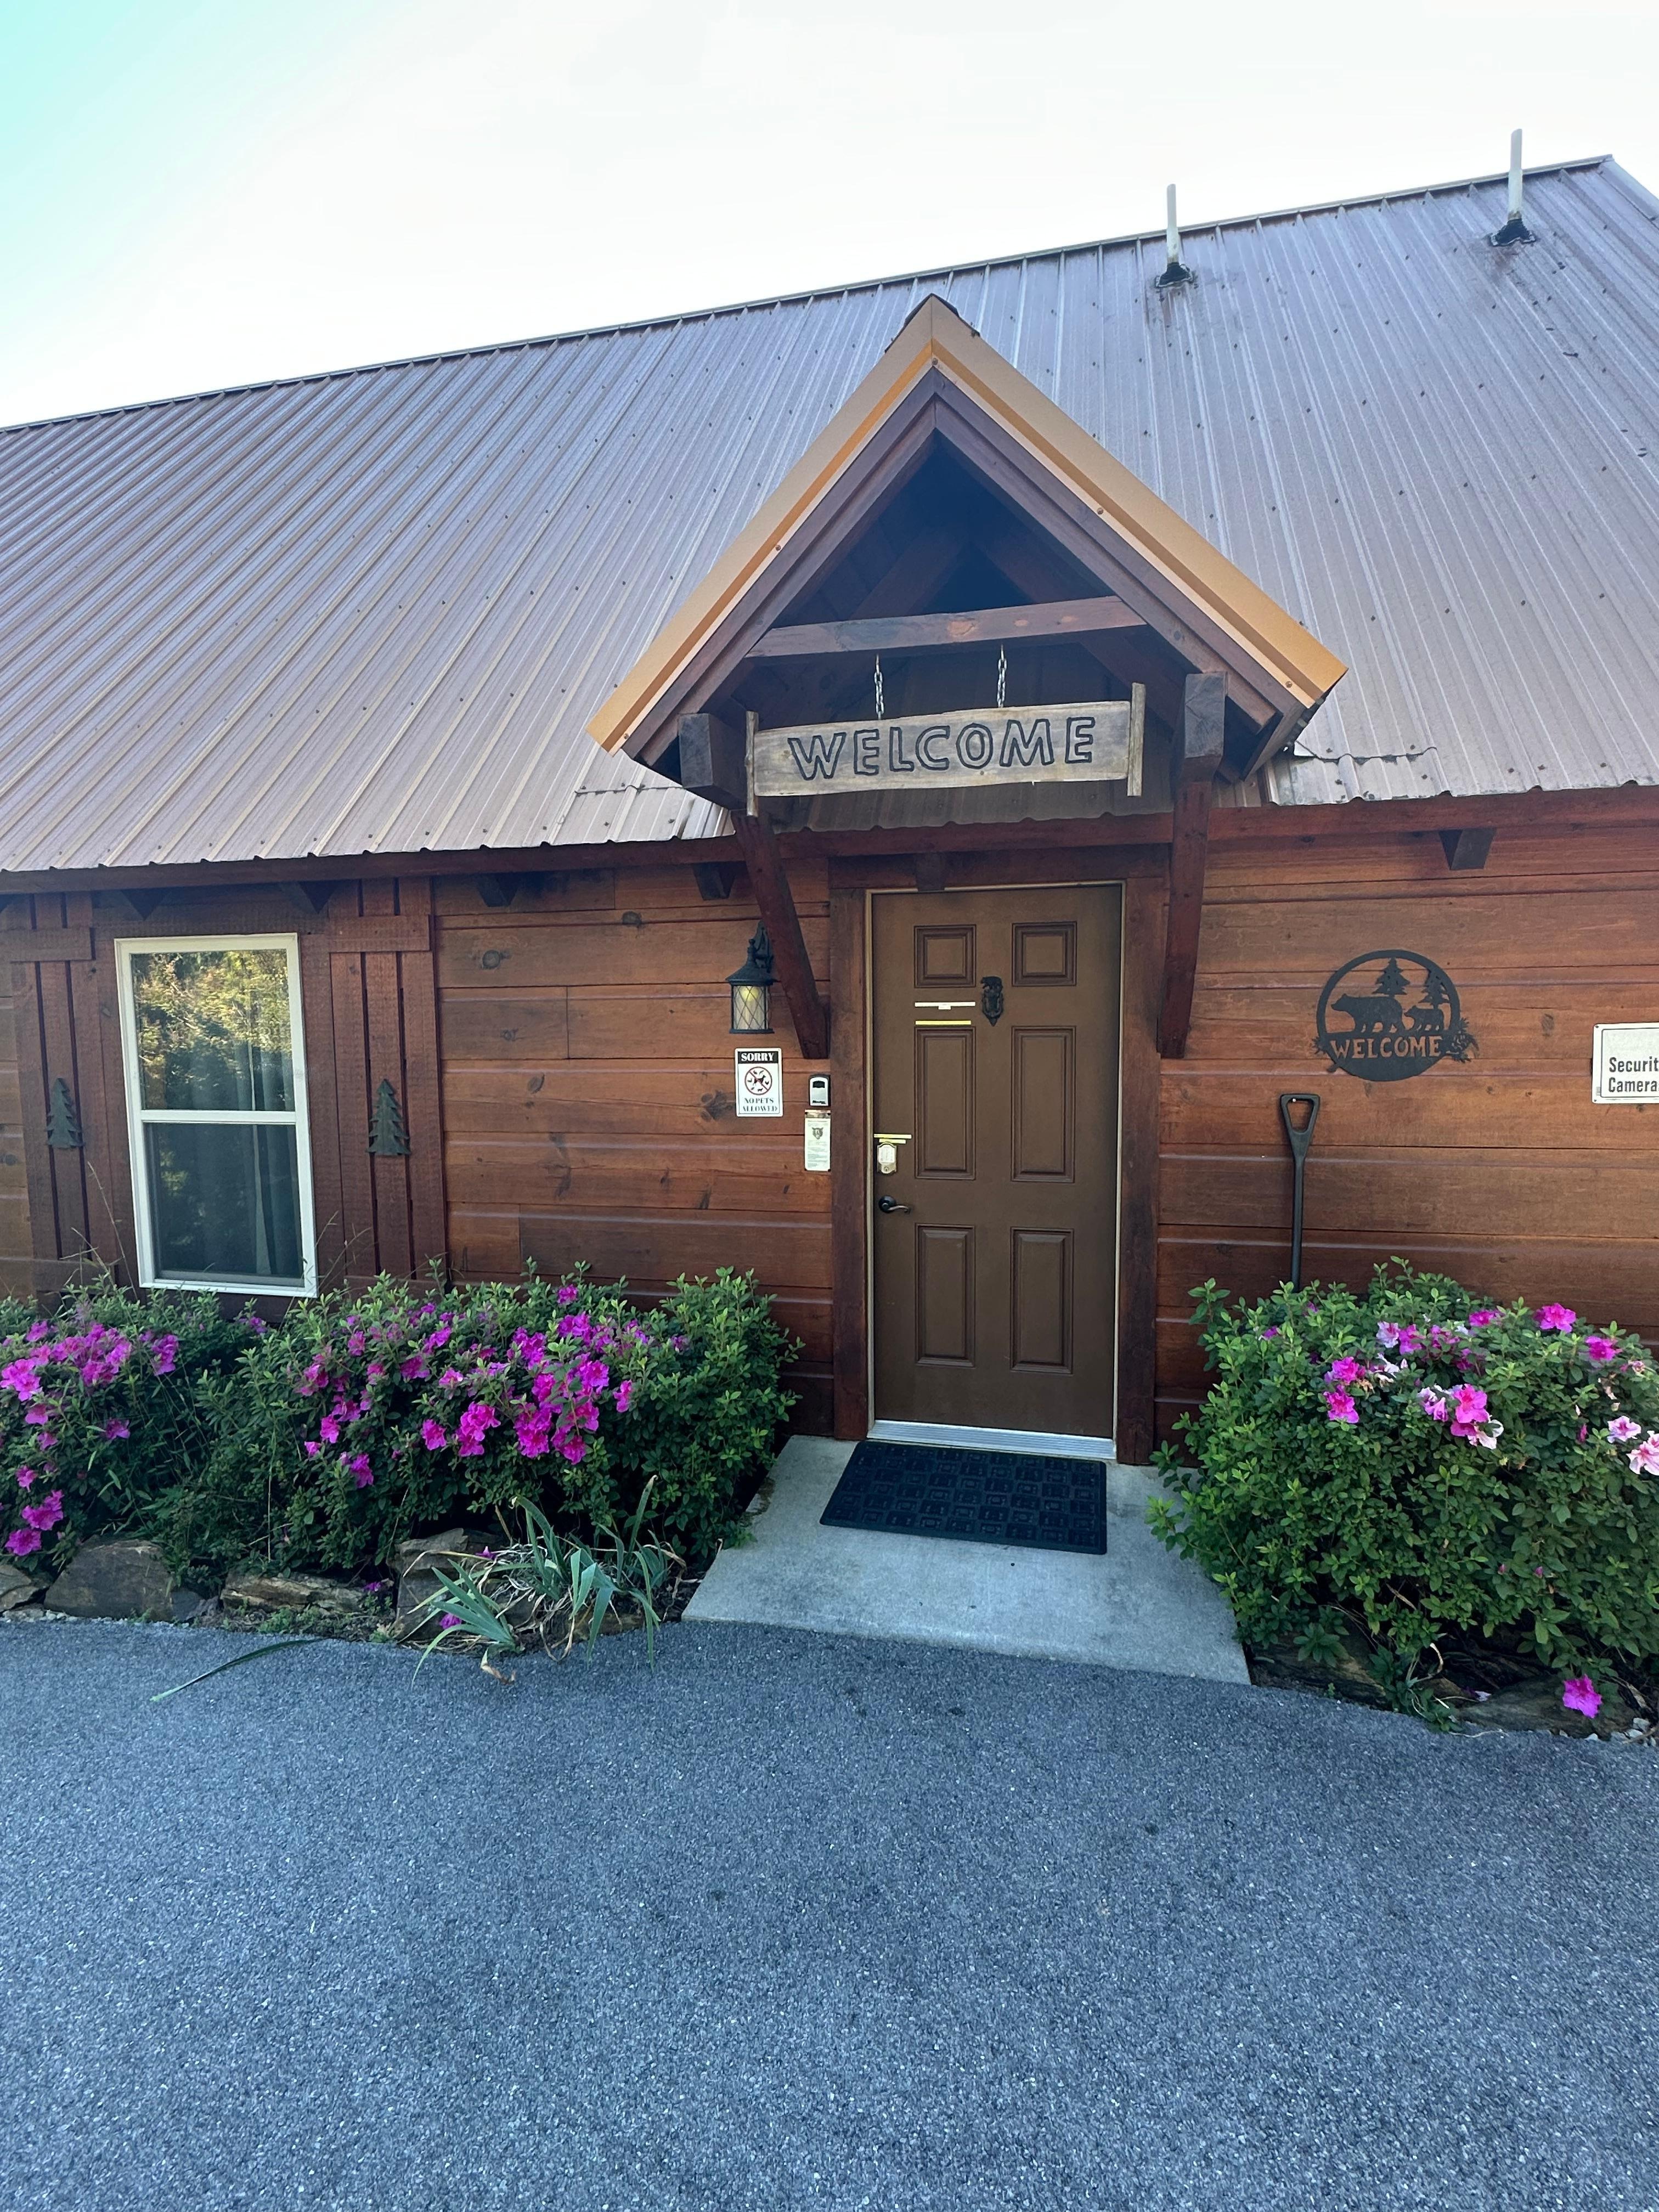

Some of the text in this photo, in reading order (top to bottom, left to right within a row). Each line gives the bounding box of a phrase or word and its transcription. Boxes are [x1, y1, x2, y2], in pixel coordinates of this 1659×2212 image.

[788, 716, 1096, 781] WELCOME
[1330, 1035, 1443, 1059] WELCOME
[741, 1052, 775, 1062] SORRY
[1609, 1056, 1659, 1073] Securit
[1609, 1076, 1659, 1093] Camera
